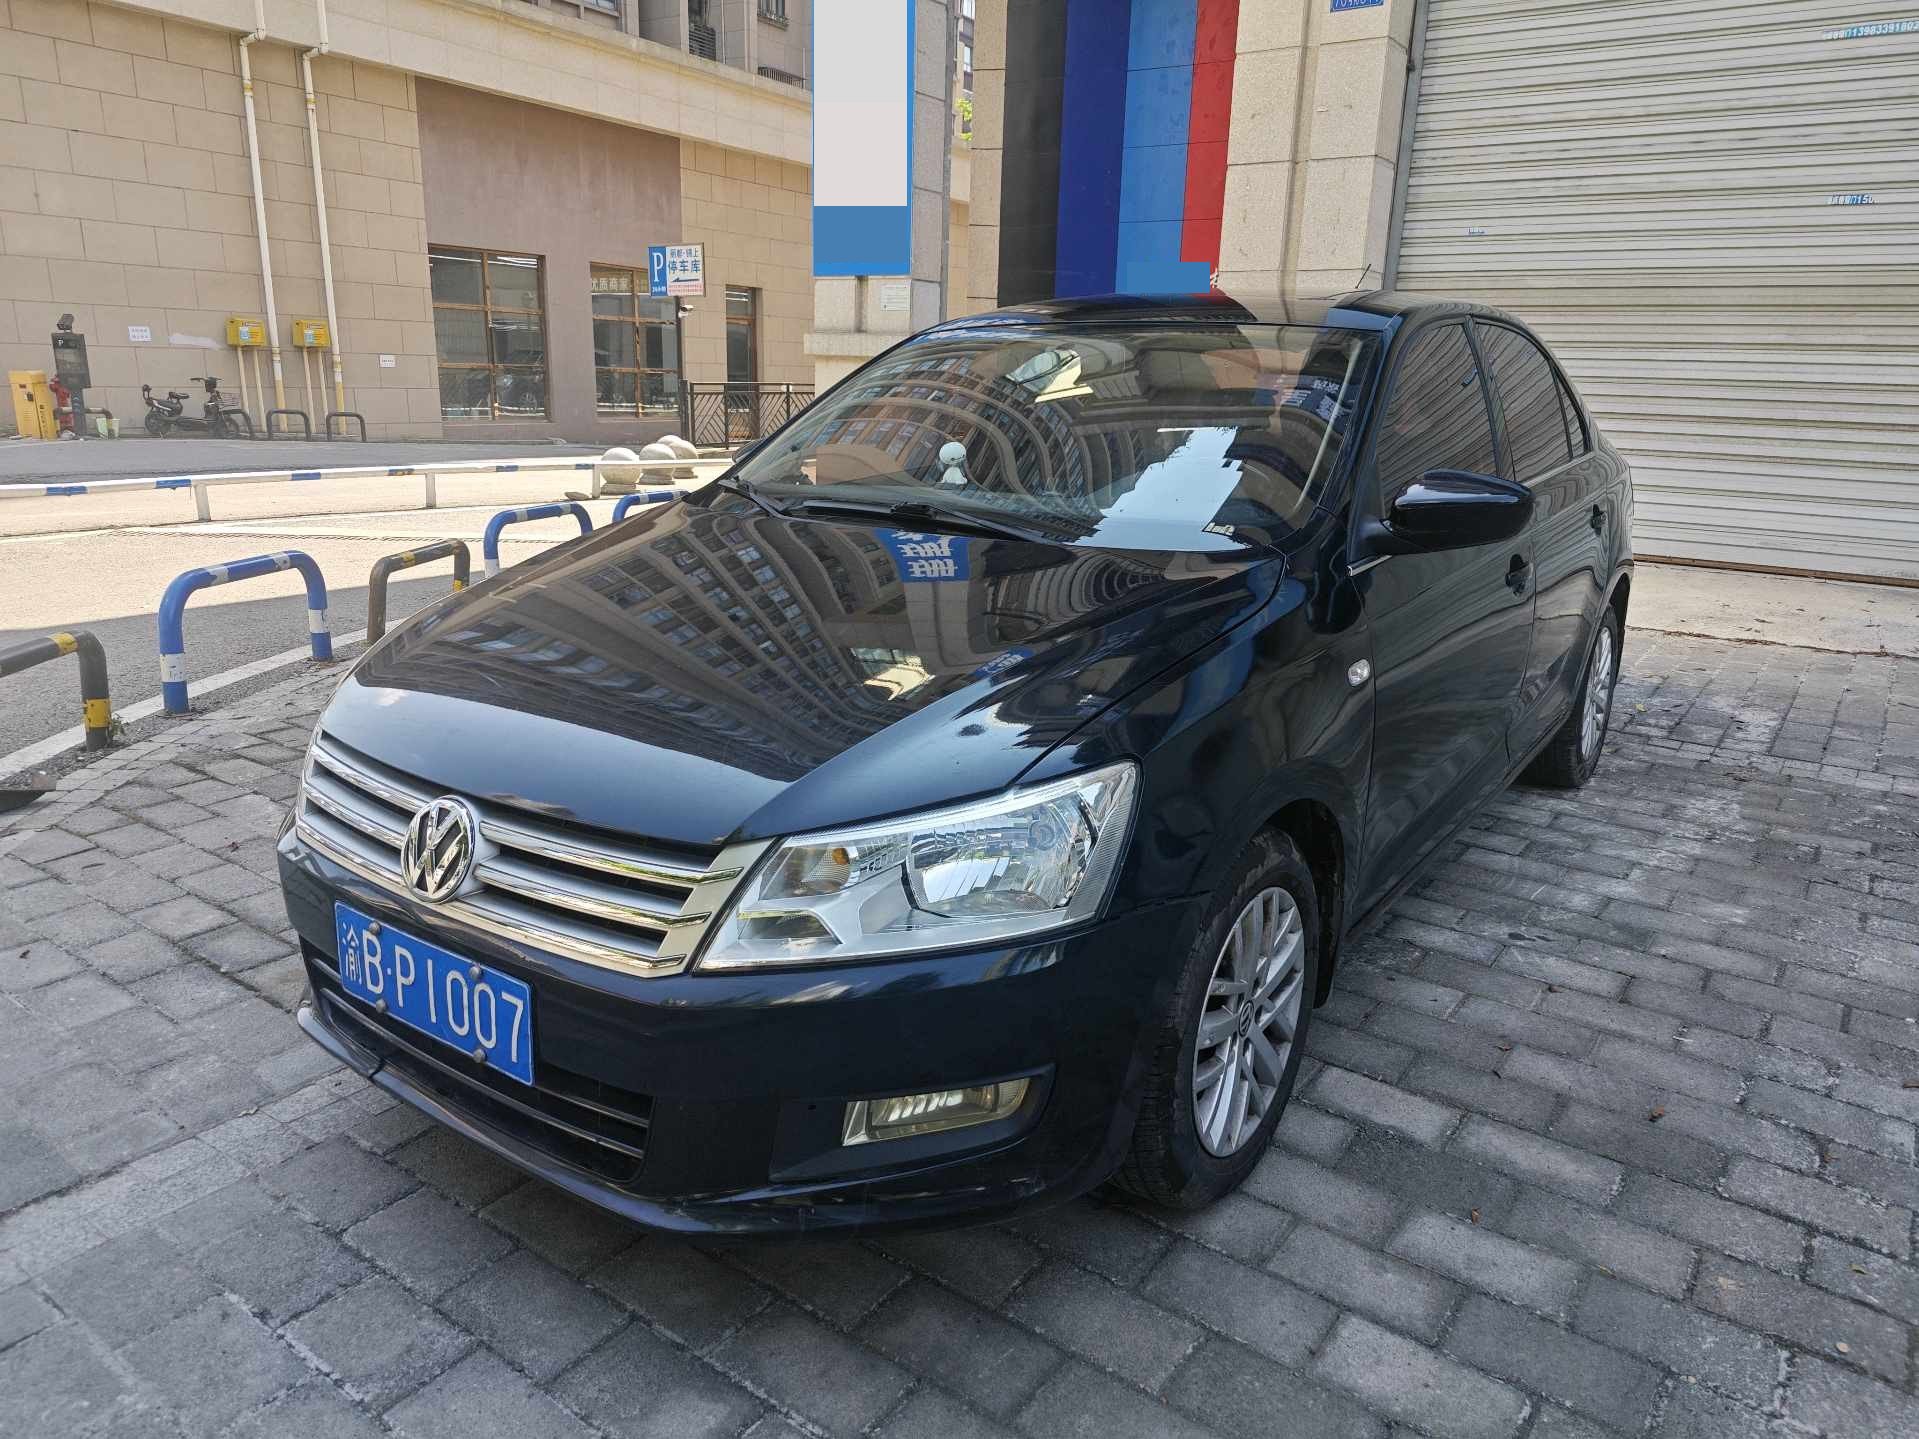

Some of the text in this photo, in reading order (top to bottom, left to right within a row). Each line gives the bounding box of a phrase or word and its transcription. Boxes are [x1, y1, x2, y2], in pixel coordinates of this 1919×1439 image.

[652, 252, 664, 281] P
[668, 259, 701, 273] 停车库
